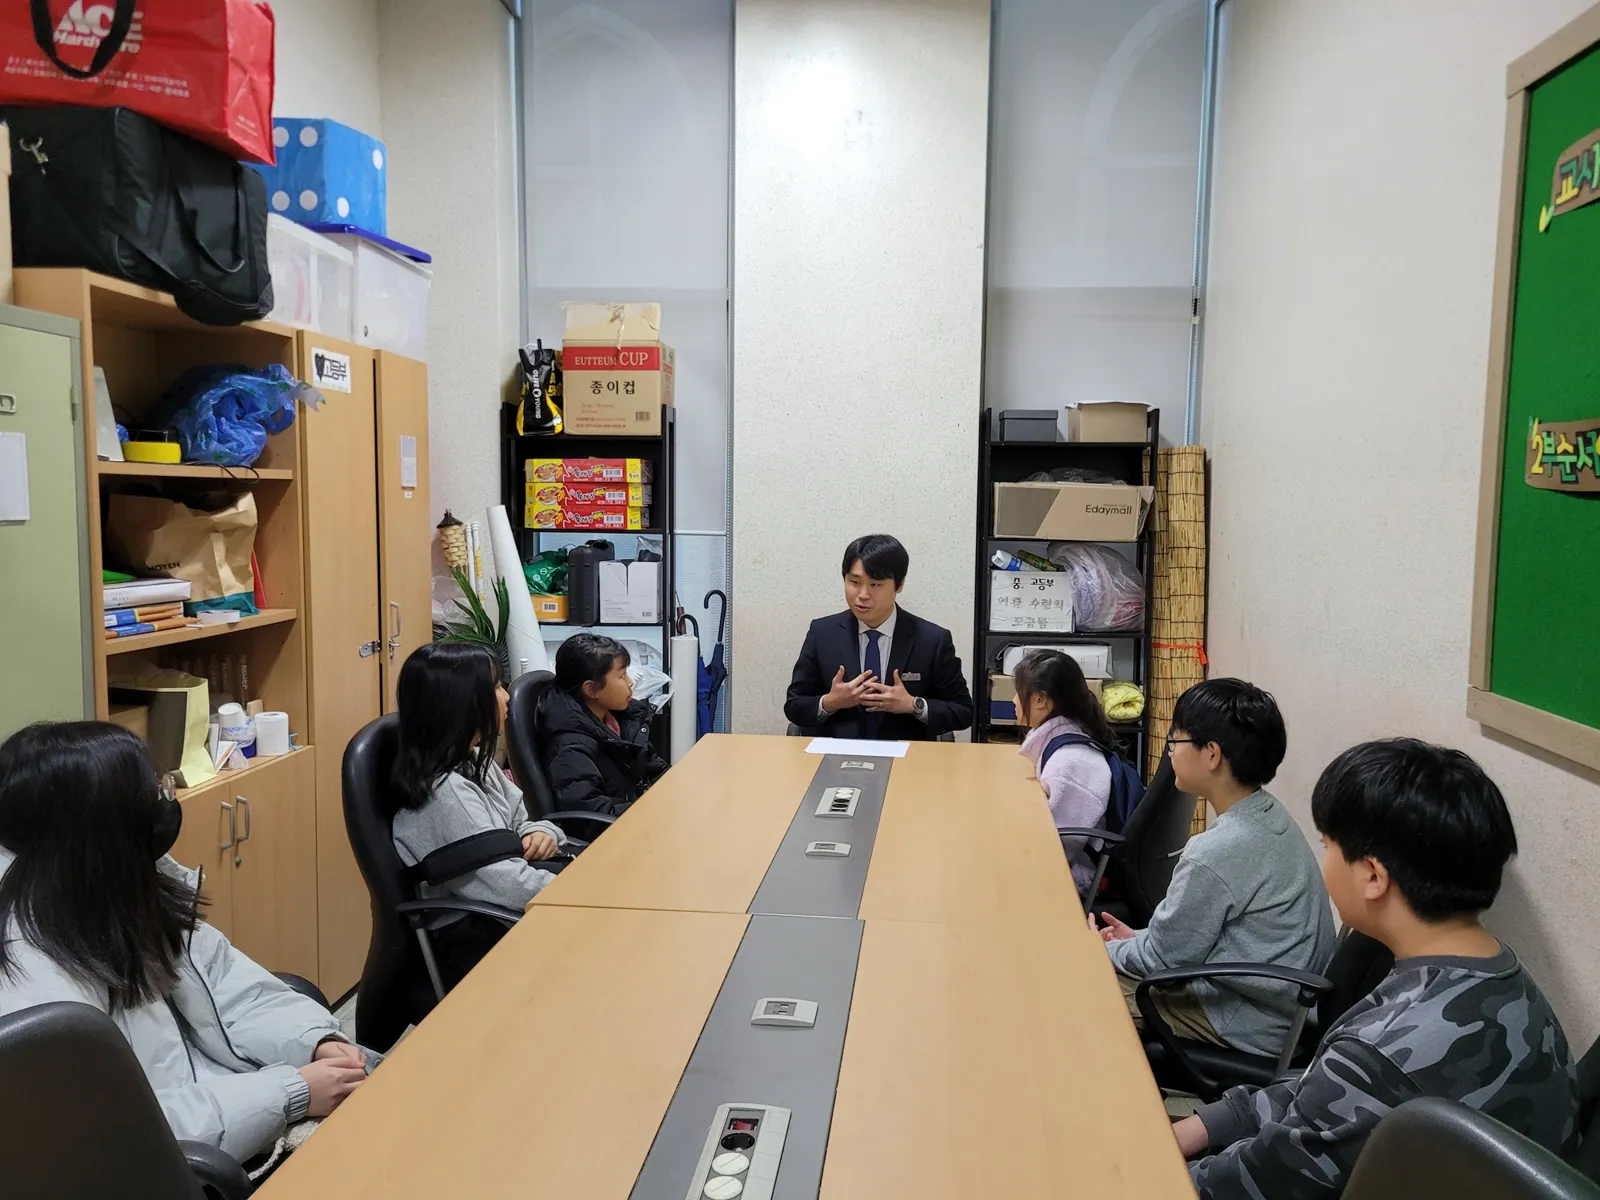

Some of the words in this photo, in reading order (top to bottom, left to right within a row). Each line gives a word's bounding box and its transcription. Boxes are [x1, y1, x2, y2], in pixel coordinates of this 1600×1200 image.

[53, 30, 141, 53] Hardre
[575, 356, 617, 366] EUTTEUM
[619, 351, 649, 366] CUP
[532, 369, 540, 388] OLIVE
[590, 380, 635, 395] 종이컵
[534, 397, 542, 419] YOUNG
[1531, 431, 1600, 481] 2부순서
[1085, 504, 1132, 516] Edaymall
[1030, 577, 1054, 591] 고등부
